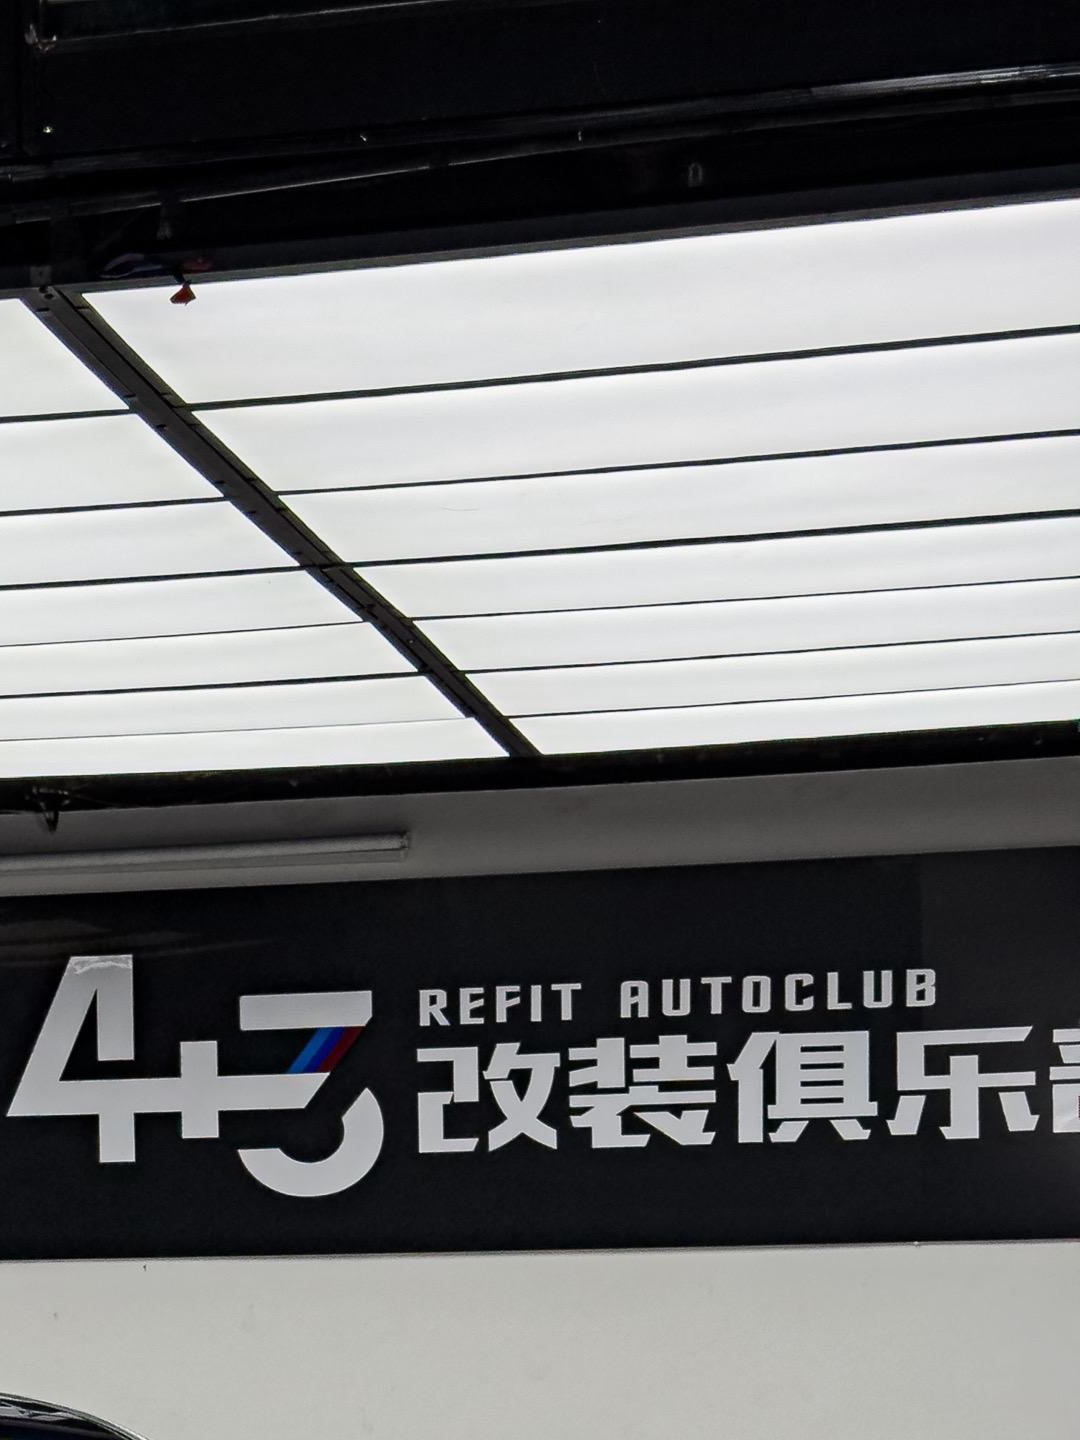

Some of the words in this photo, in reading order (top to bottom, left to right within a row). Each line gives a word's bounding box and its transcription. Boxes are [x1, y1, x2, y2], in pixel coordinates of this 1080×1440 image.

[419, 983, 582, 1026] REFIT
[621, 968, 938, 1019] AUTOCLUB
[416, 1025, 1080, 1153] 改装俱乐
